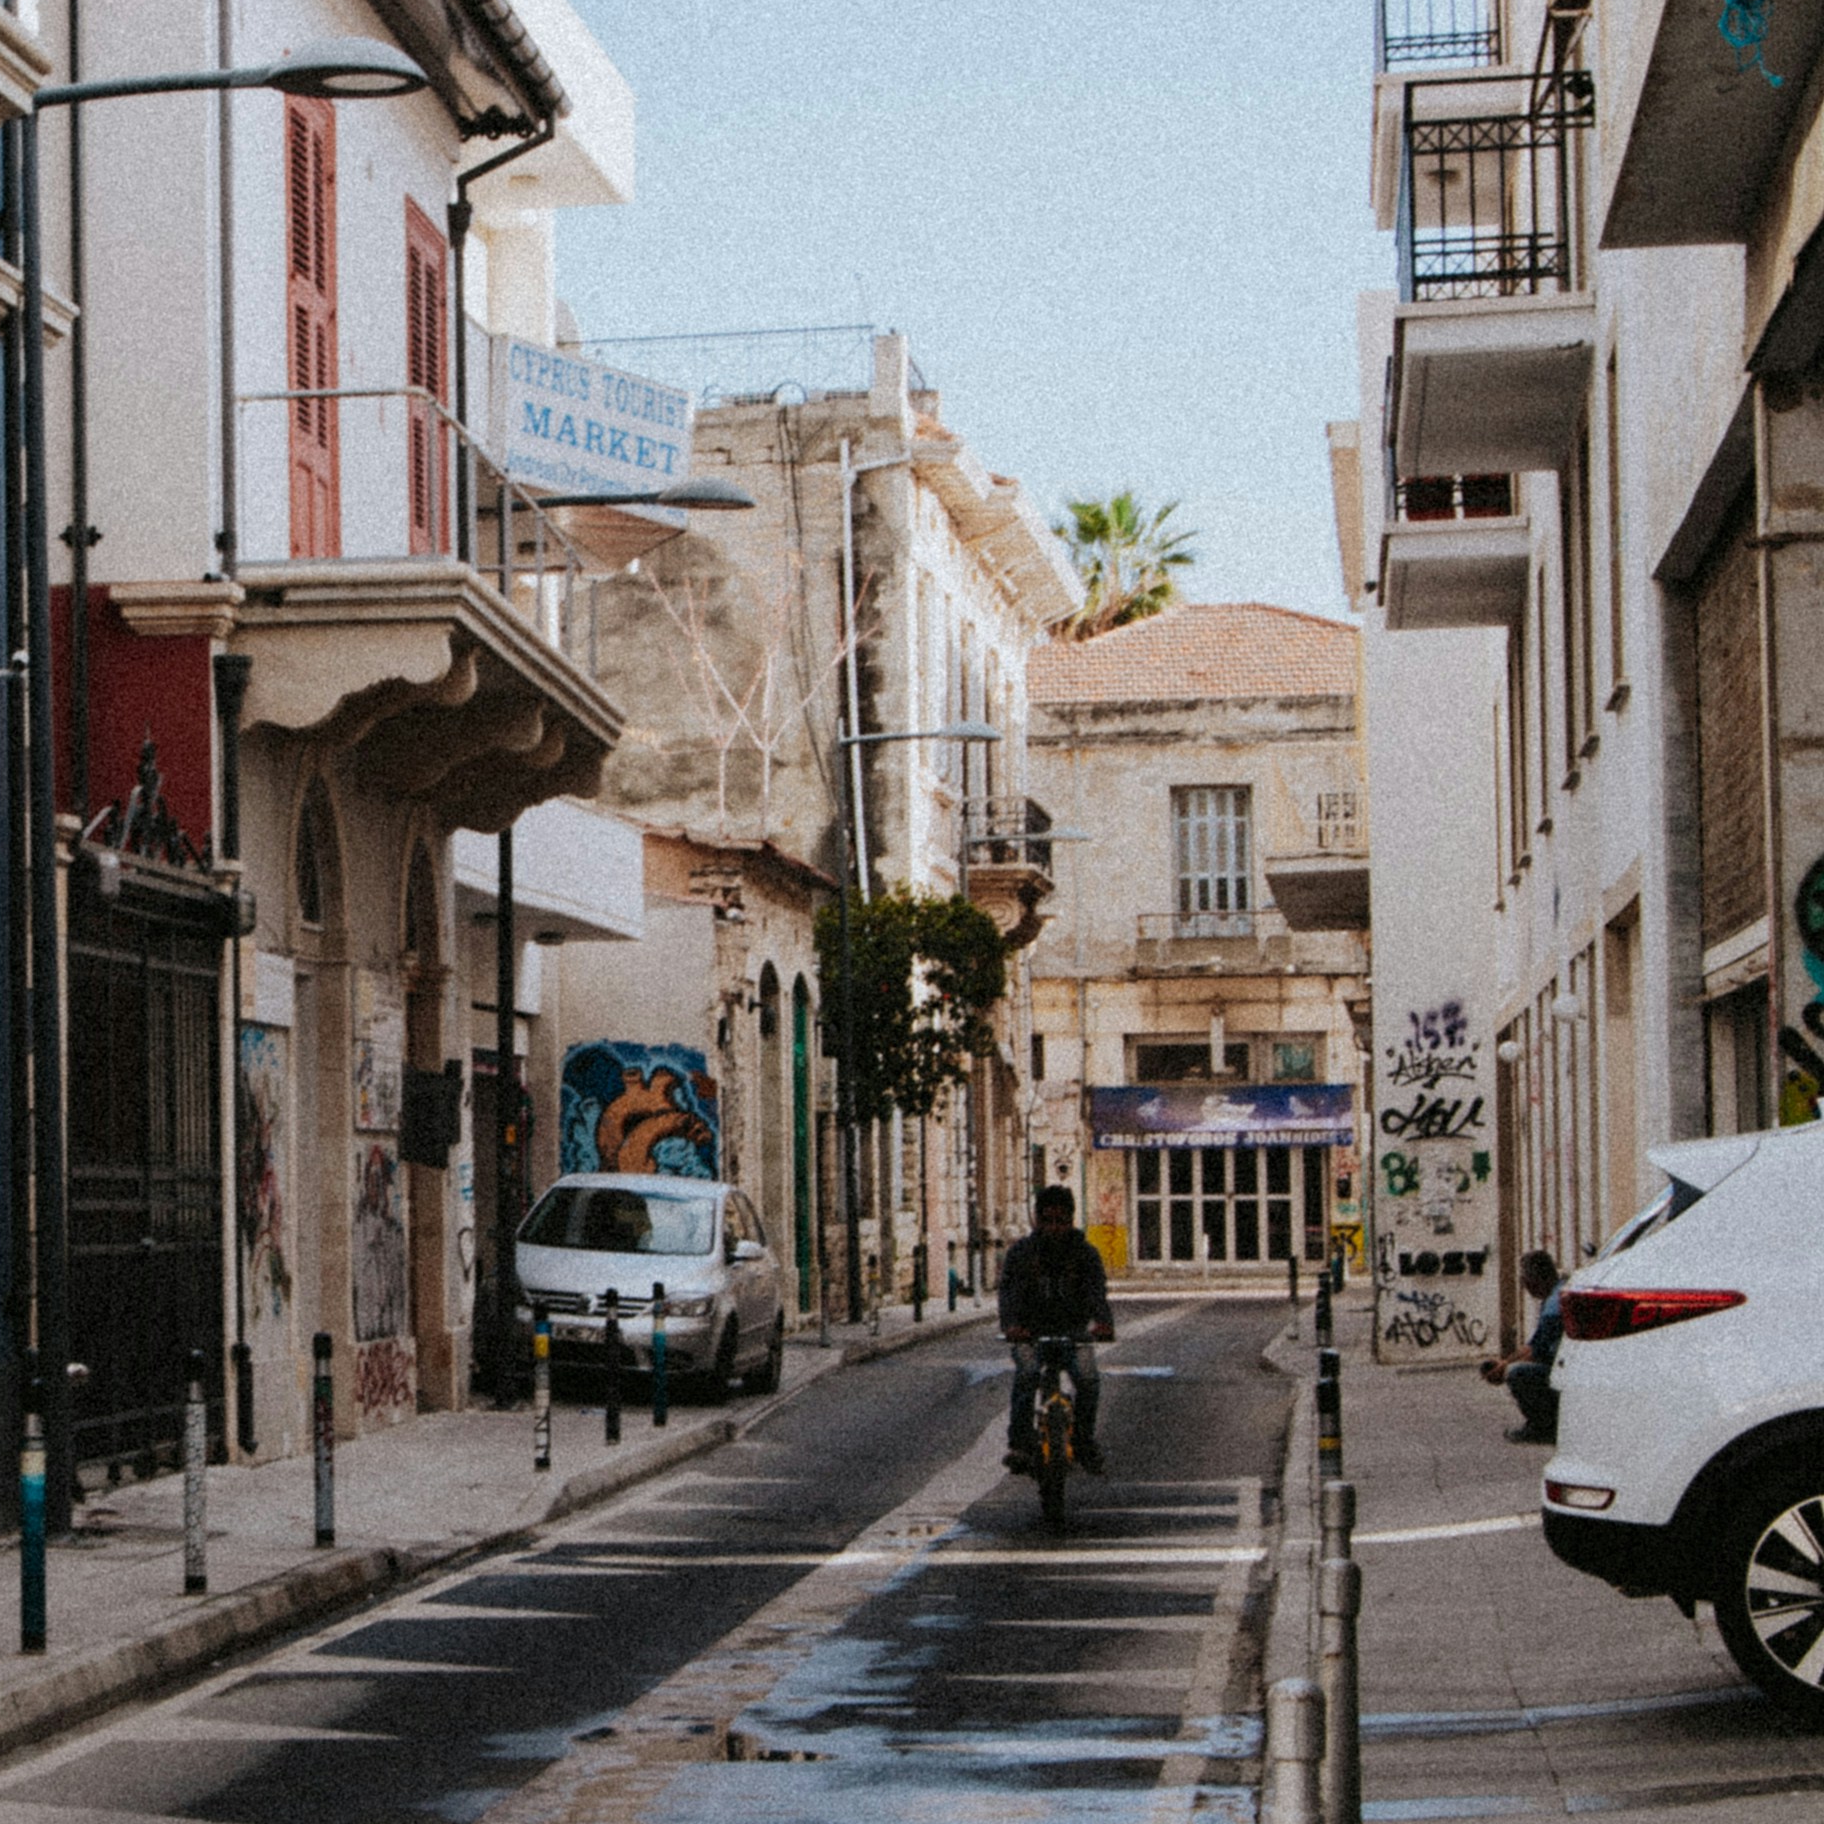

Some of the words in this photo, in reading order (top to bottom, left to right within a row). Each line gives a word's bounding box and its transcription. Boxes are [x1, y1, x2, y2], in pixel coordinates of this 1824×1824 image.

[510, 344, 590, 401] CYPRUS
[602, 373, 688, 430] TOURIST
[523, 400, 678, 475] MARKET
